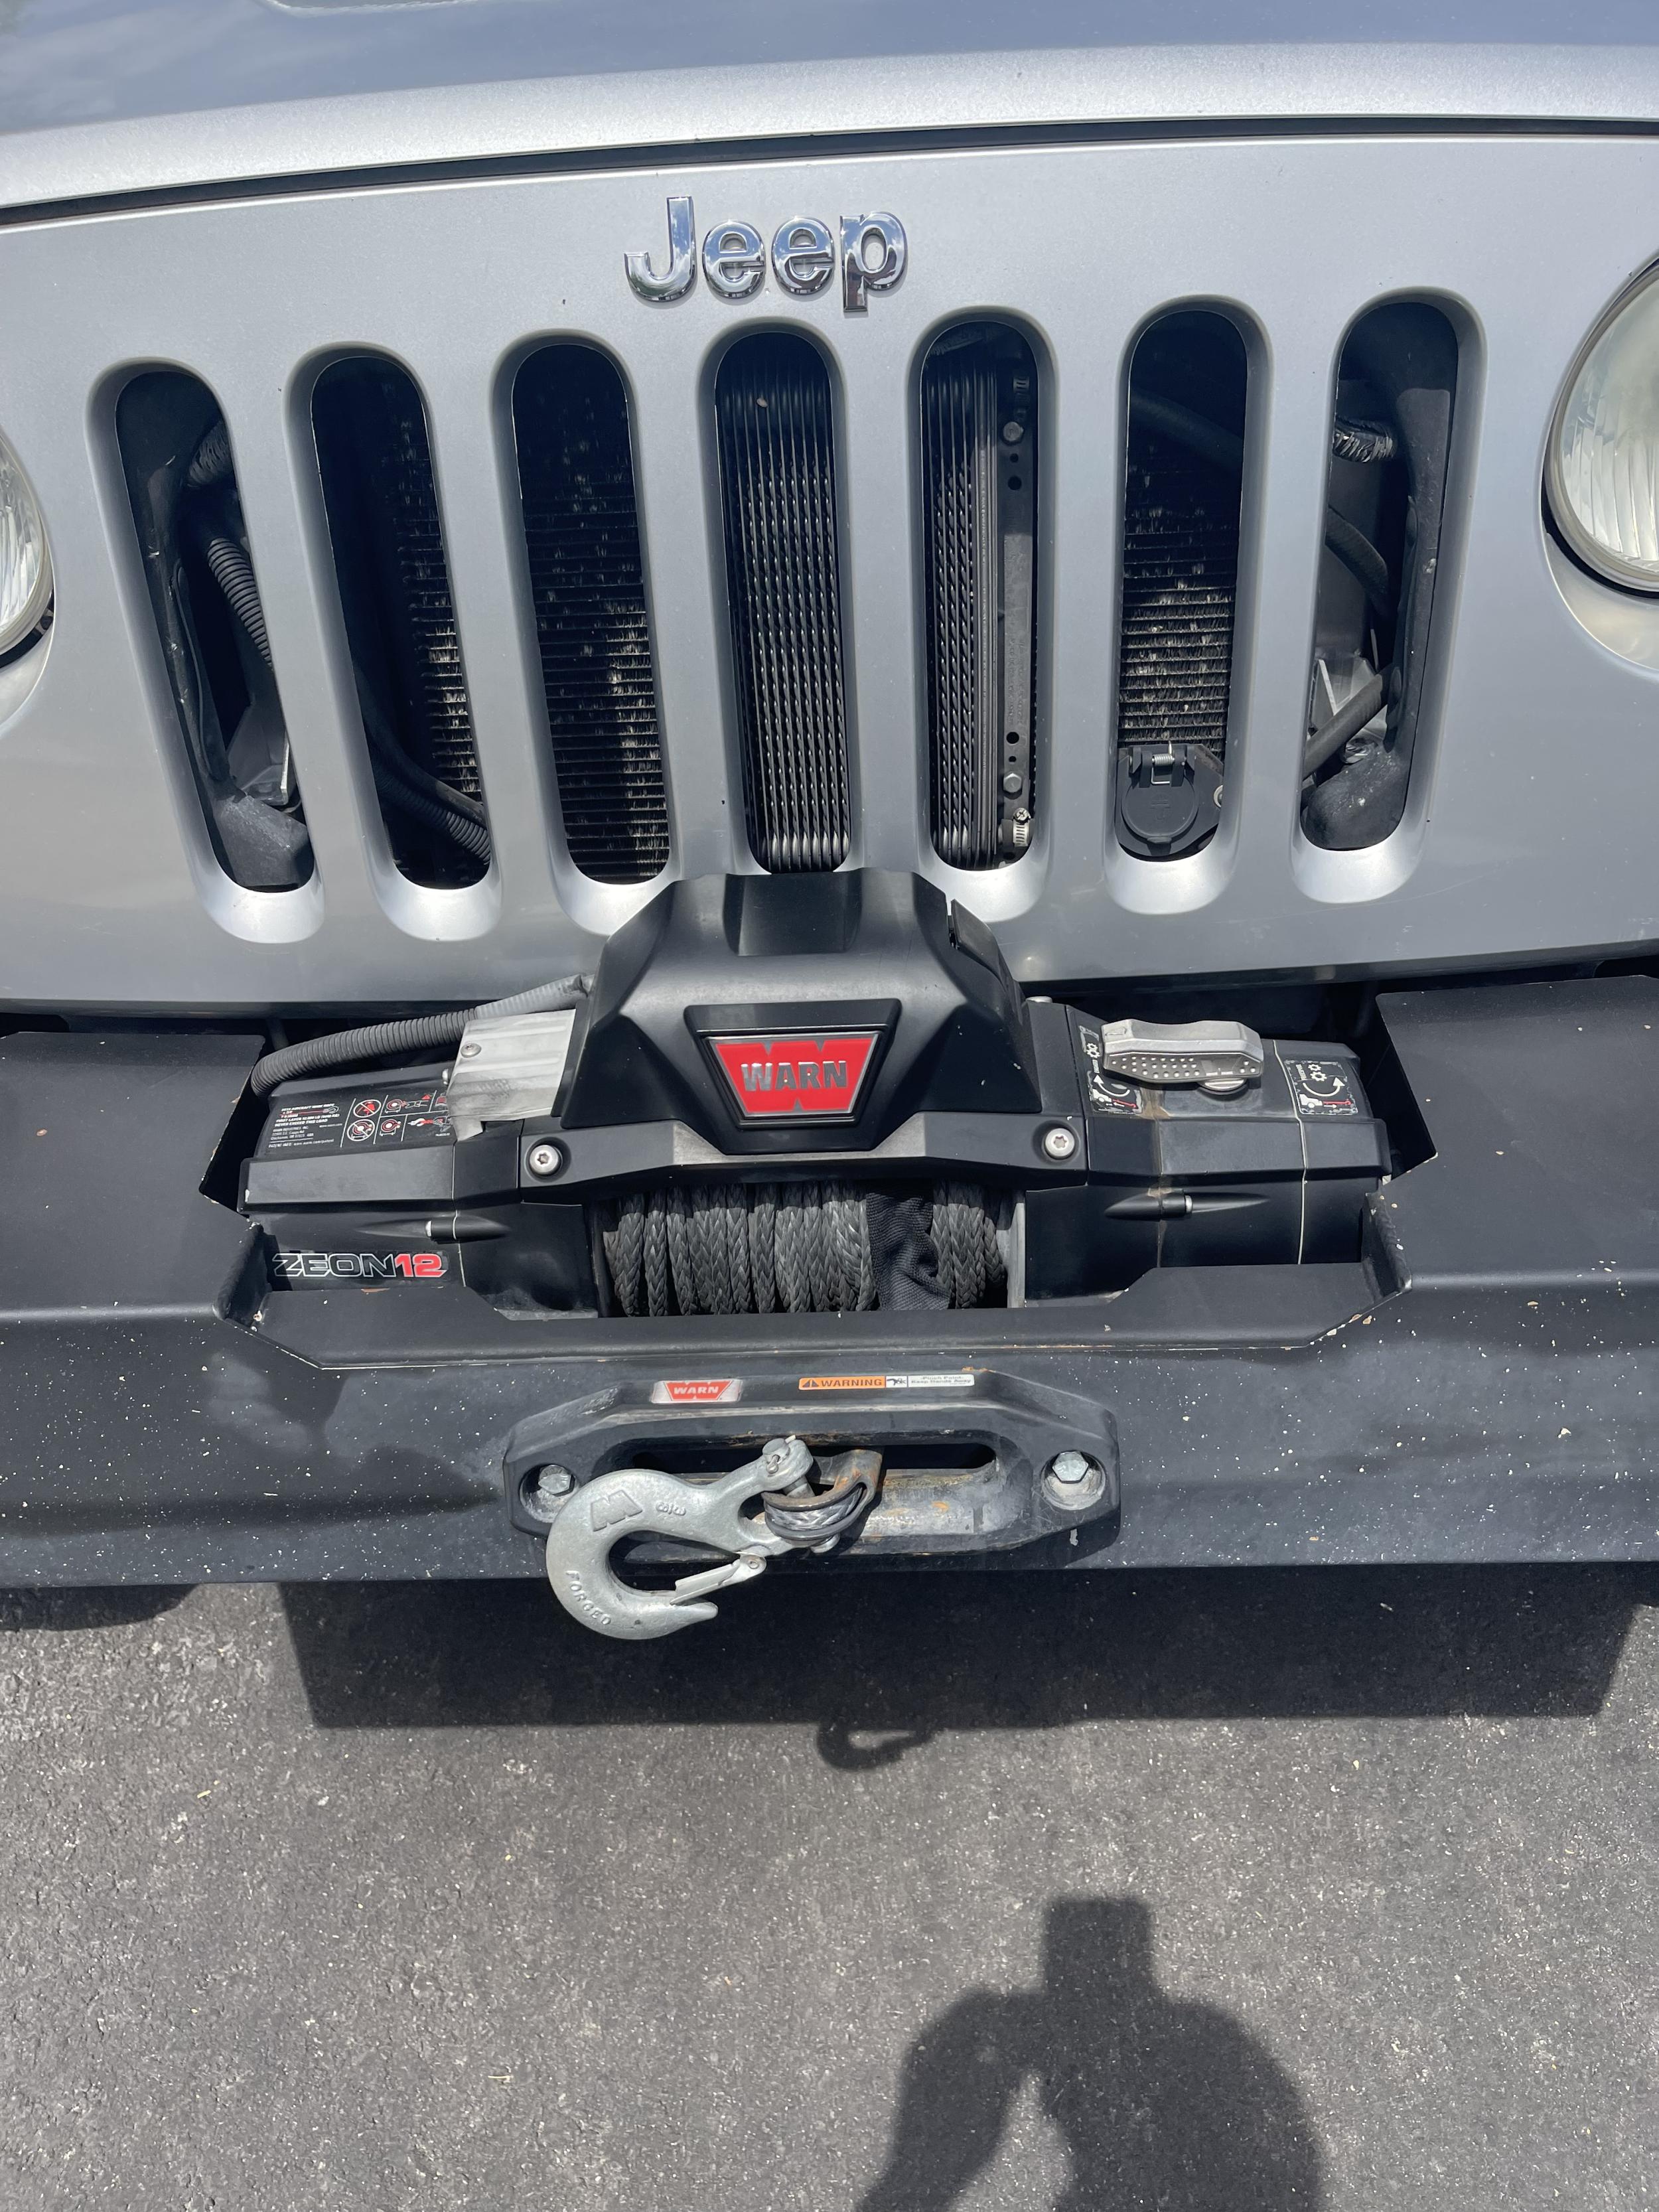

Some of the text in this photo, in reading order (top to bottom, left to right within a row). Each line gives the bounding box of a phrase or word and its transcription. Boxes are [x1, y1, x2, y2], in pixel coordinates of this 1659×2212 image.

[624, 196, 908, 312] Jeep
[741, 1061, 847, 1092] WARN
[272, 1253, 448, 1278] ZEON12
[674, 1386, 719, 1394] WARN
[565, 1570, 612, 1625] FORGED
